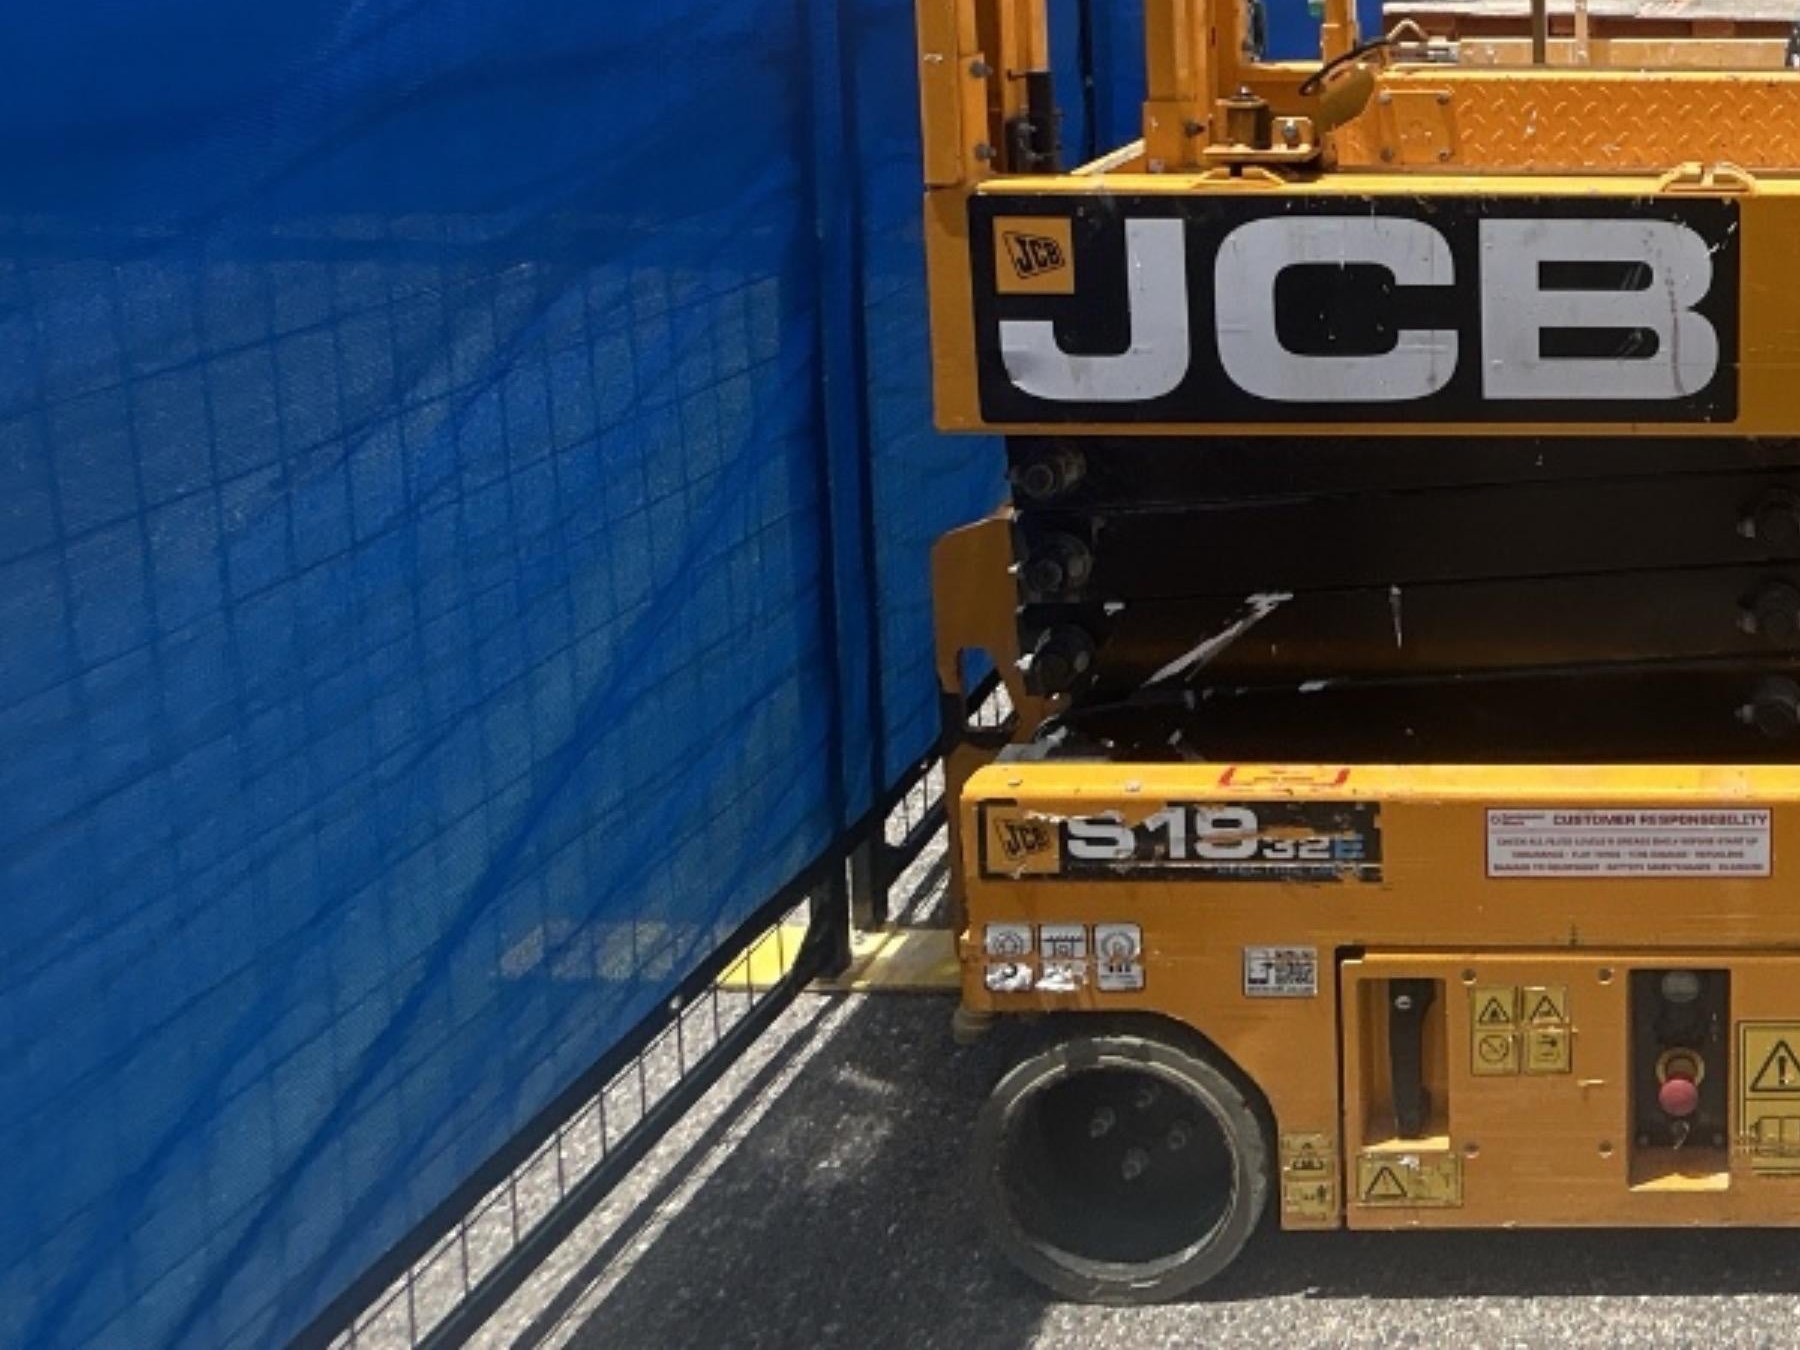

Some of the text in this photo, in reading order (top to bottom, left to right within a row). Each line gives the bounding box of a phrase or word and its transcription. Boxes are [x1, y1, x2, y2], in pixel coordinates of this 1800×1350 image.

[1014, 233, 1063, 274] JCB
[998, 214, 1720, 403] JCB
[1552, 813, 1637, 827] CUSTOMER
[1639, 813, 1768, 827] RESPONSIBILITY
